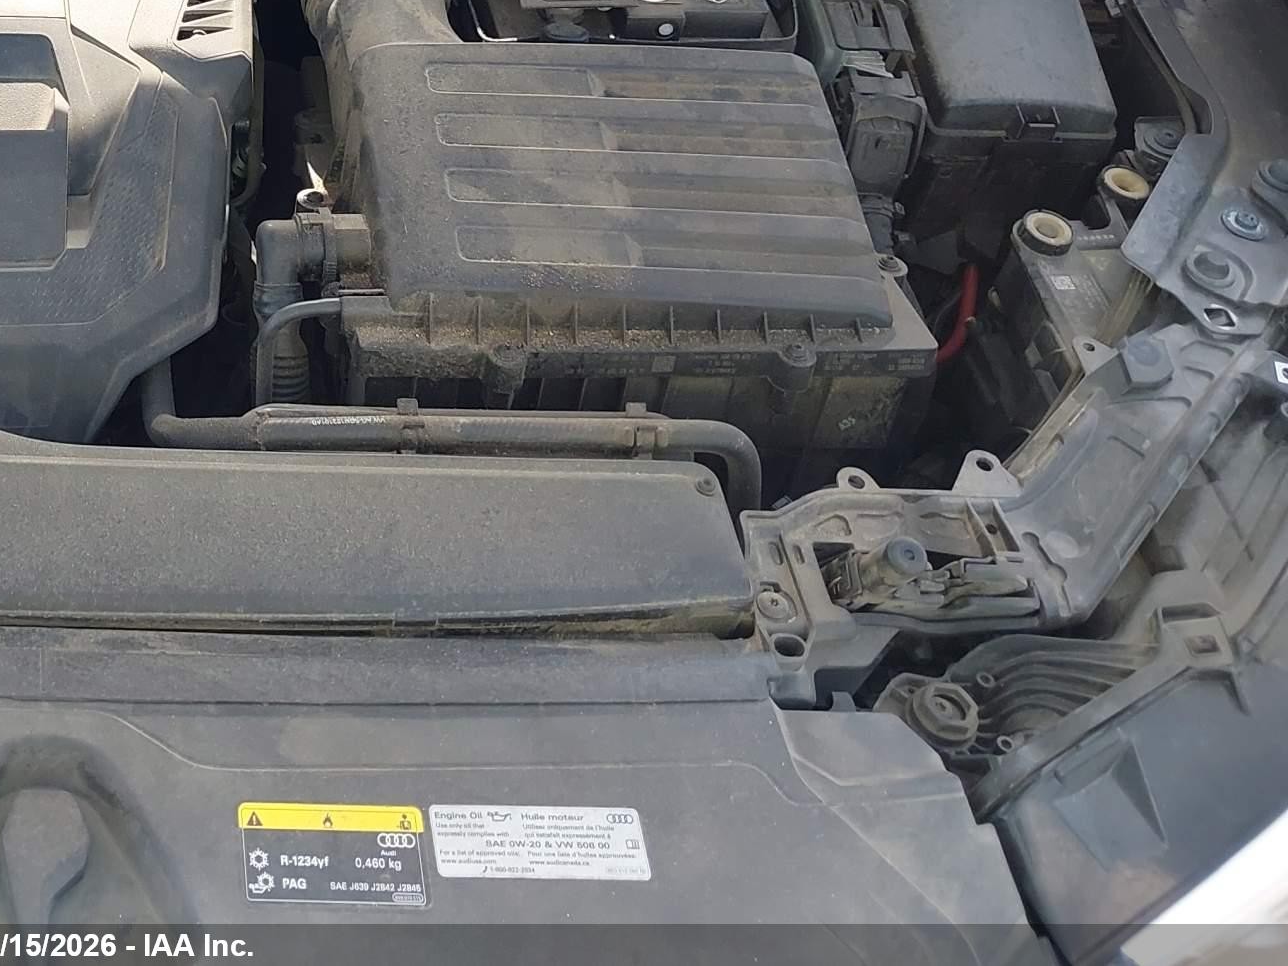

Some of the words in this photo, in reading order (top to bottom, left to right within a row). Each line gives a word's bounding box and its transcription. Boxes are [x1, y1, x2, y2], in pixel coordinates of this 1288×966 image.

[434, 811, 467, 820] Engine
[469, 811, 483, 819] Oil
[521, 813, 546, 821] Huile
[509, 840, 541, 848] 0W-20
[555, 841, 574, 849] VW
[280, 855, 329, 869] R-1234yf
[388, 858, 402, 871] kg
[282, 877, 307, 890] PAG
[330, 881, 347, 890] SAE
